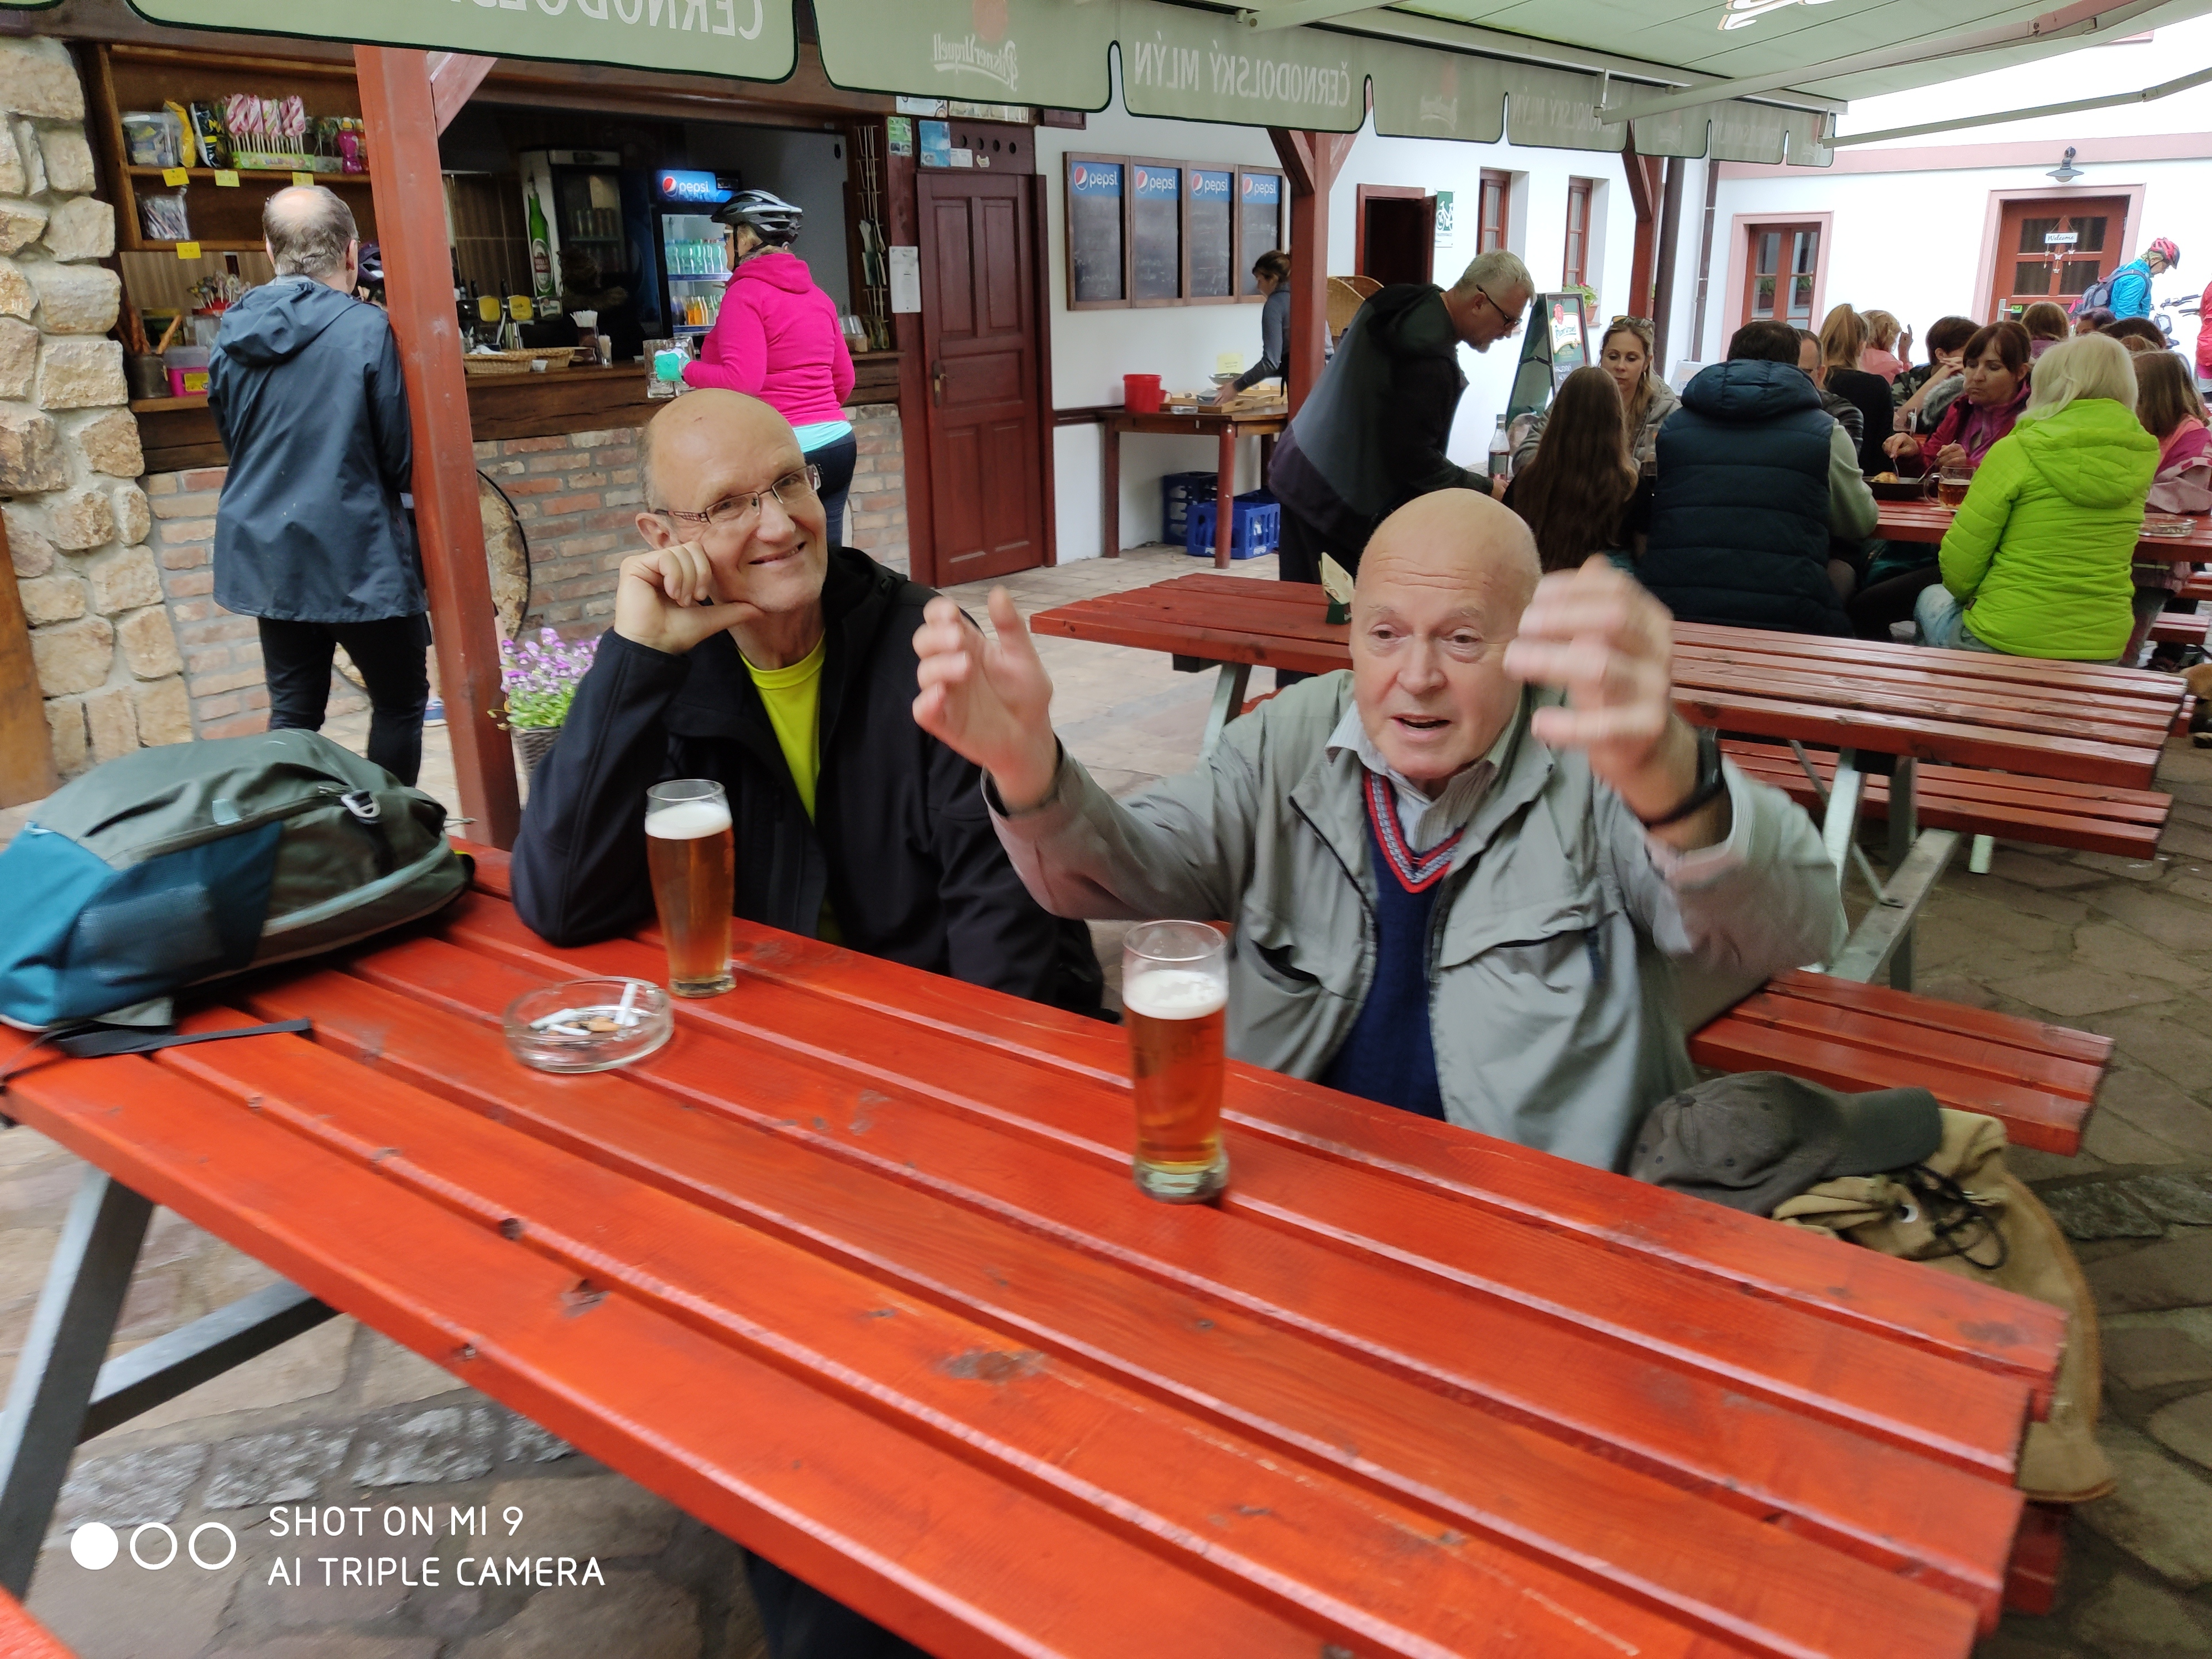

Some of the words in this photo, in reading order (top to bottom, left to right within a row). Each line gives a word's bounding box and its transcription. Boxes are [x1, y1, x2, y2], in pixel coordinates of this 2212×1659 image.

[679, 181, 709, 194] pepsi
[1089, 171, 1118, 189] pepsi
[1150, 176, 1176, 192] pepsi
[1204, 179, 1228, 194] pepsi
[1254, 181, 1276, 197] pepsi
